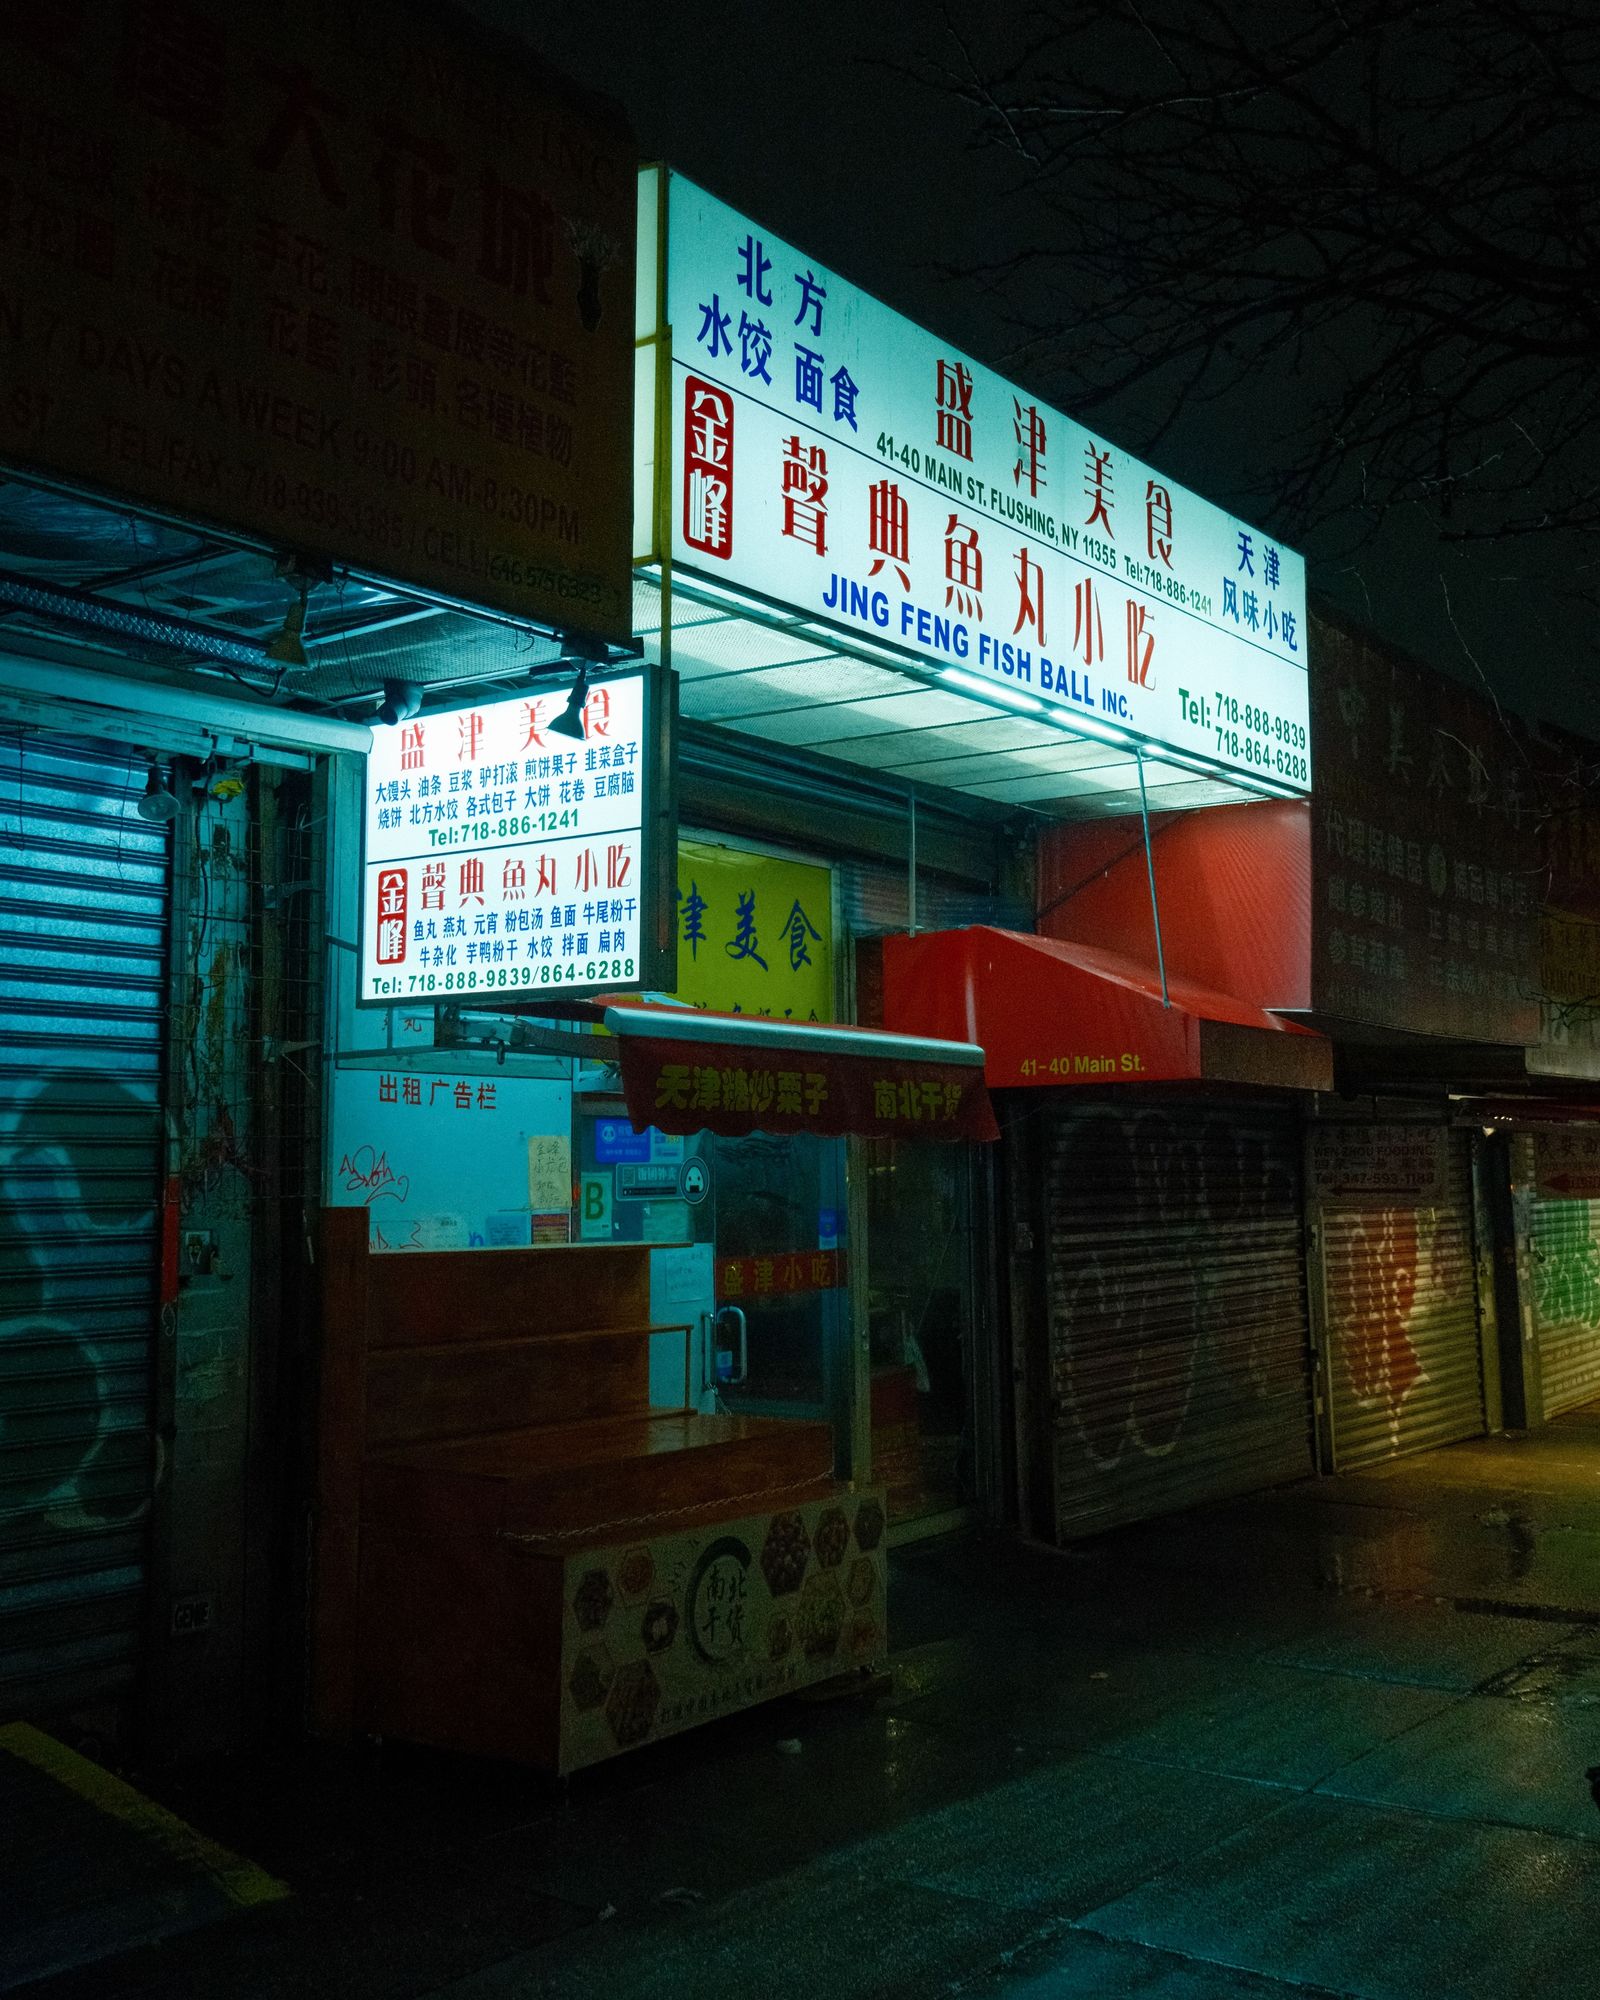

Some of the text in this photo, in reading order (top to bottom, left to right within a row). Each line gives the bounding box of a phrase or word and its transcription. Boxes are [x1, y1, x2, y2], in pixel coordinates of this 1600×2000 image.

[737, 234, 827, 337] 北方
[697, 293, 860, 433] 水饺 面食
[935, 359, 1175, 571] 盛津美食
[876, 432, 920, 474] 41-40
[925, 454, 963, 496] MAIN
[967, 475, 987, 507] ST.
[991, 488, 1059, 546] FLUSHING,
[1062, 522, 1079, 550] NY
[1083, 534, 1117, 569] 11355
[1237, 531, 1280, 591] 天津
[1222, 576, 1298, 652] 风味小吃
[823, 573, 1134, 721] JING FENG FISH BALL INC.
[400, 688, 612, 772] 盛津美食
[1178, 687, 1306, 751] Tel: 718-888-9839
[375, 741, 639, 805] 大馒头 油条 豆浆 驴打滚 煎饼果子 韭菜盒子
[1215, 726, 1307, 782] 718-864-6288
[377, 770, 635, 830] 烧饼 北方水饺 各式包子 大饼 花卷 豆腐脑
[413, 897, 637, 941] 鱼丸 燕丸 元宵 粉包汤 鱼面 牛尾粉干
[419, 929, 626, 969] 牛杂化 芋鸭粉干 水饺 拌面 扁肉
[372, 958, 635, 995] Tel: 718-888-9839/864-6288
[378, 1074, 498, 1111] 出租广告栏
[655, 1063, 965, 1121] 天津糖炒栗子 南北干货
[1020, 1053, 1146, 1076] 41-40 Main St.
[585, 1181, 605, 1221] B
[724, 1253, 832, 1297] 盛津小吃
